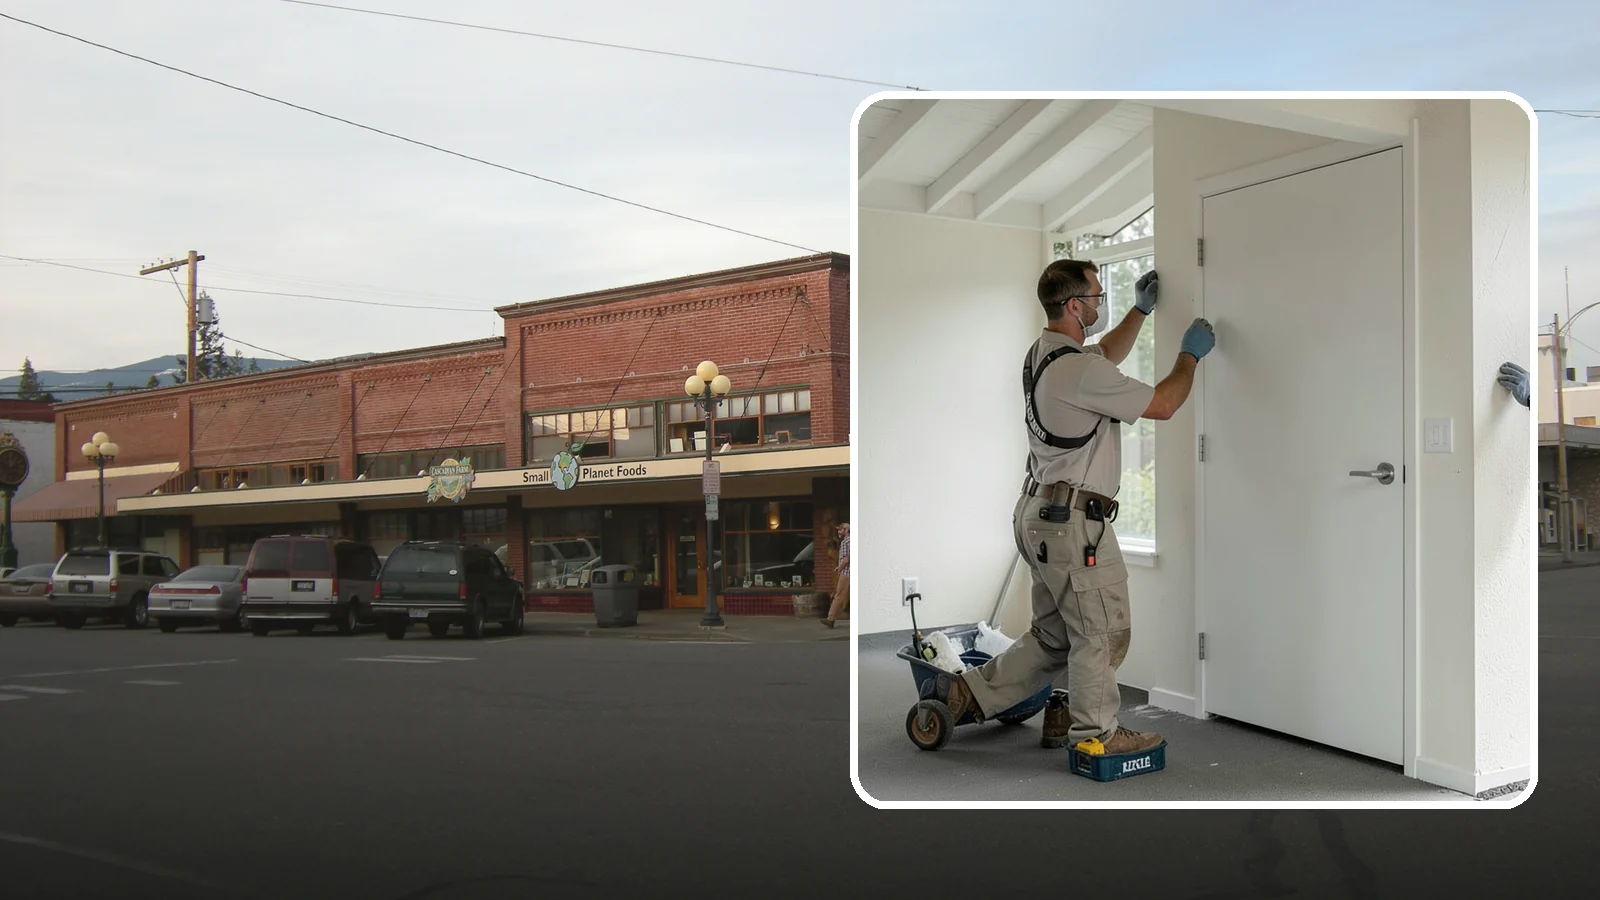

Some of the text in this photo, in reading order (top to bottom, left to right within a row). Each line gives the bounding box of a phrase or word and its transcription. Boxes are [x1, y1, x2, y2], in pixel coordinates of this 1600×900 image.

[523, 464, 647, 483] Small Planet Foods
